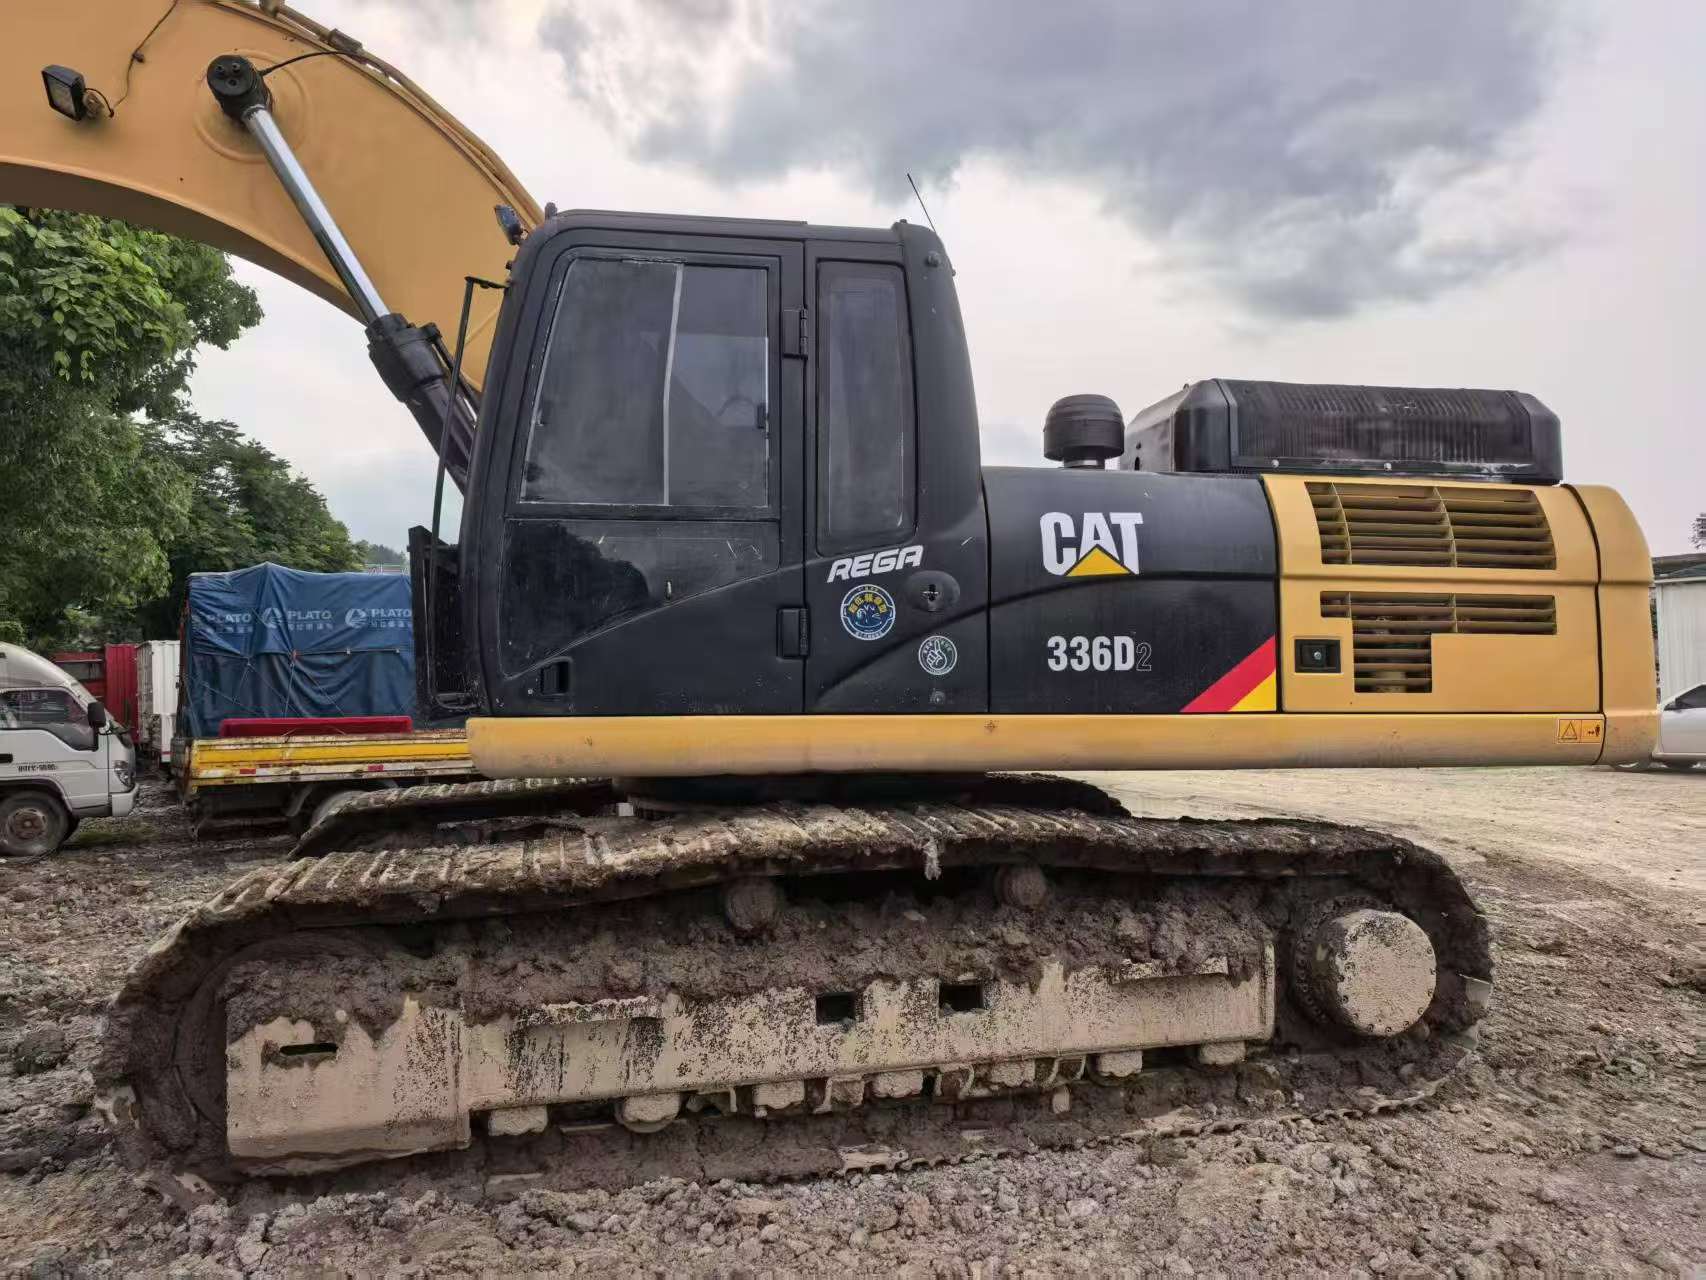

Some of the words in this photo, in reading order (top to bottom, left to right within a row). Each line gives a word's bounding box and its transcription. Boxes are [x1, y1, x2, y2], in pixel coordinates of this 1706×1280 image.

[1040, 511, 1144, 576] CAT
[826, 545, 924, 583] REGA
[287, 610, 332, 621] PLATO
[370, 607, 413, 618] PLATO
